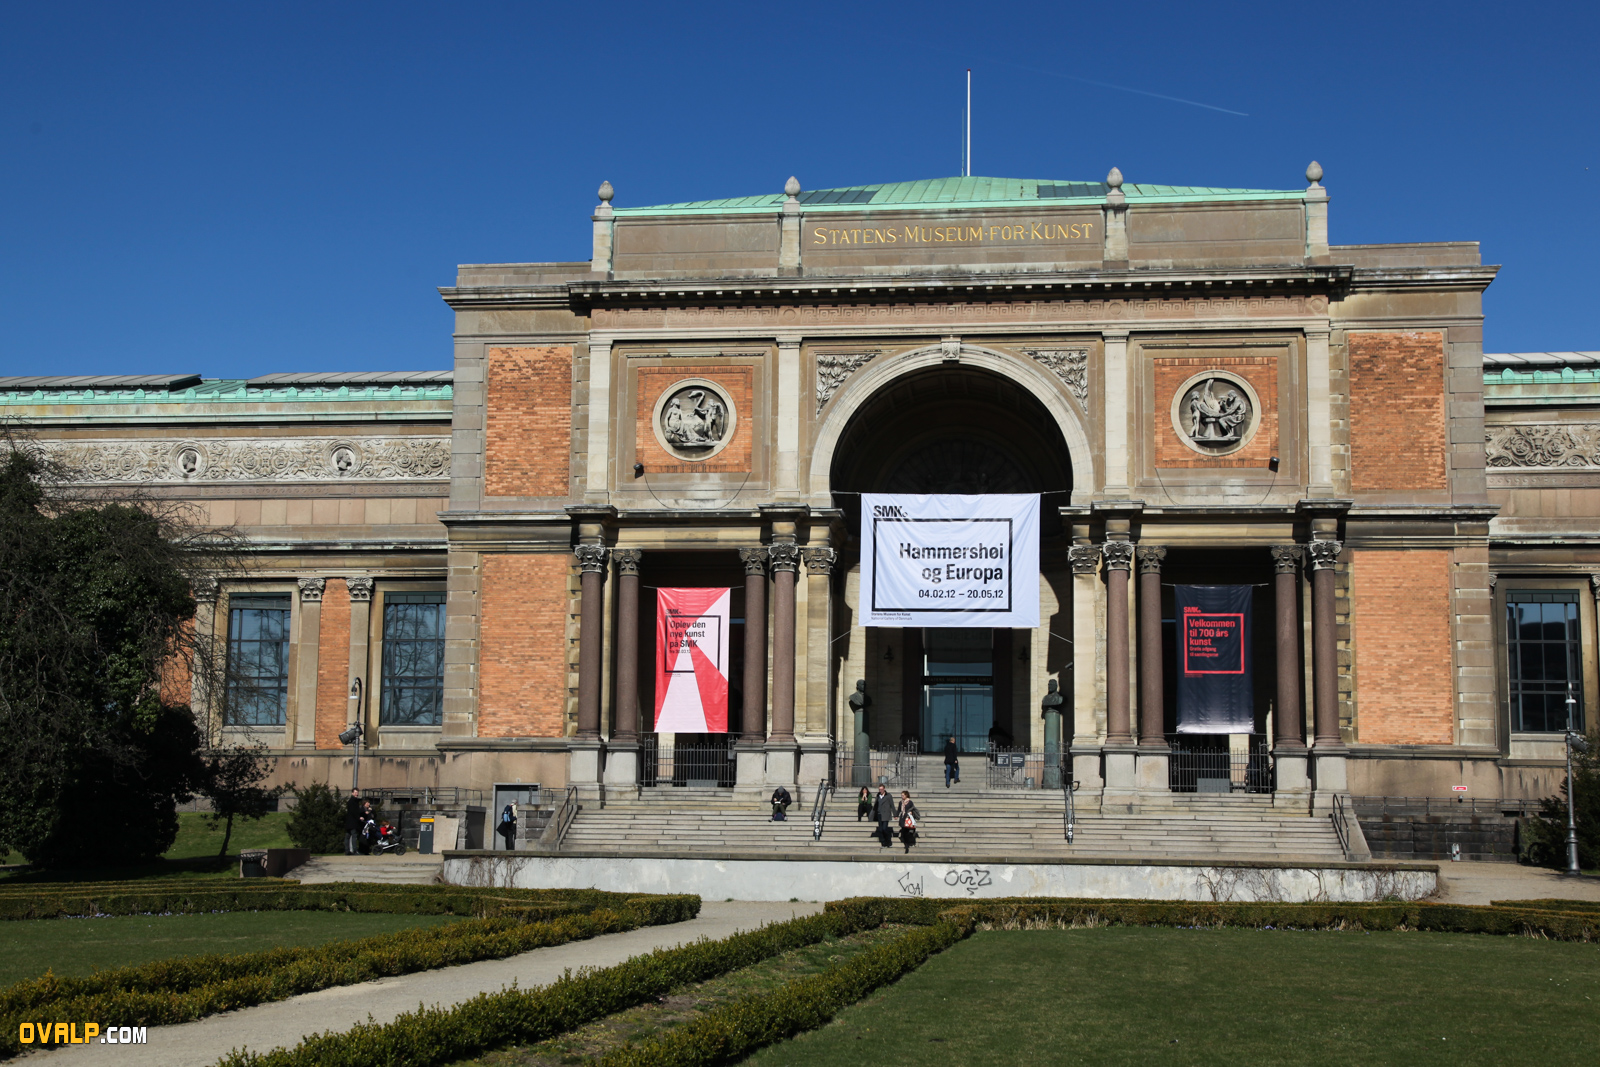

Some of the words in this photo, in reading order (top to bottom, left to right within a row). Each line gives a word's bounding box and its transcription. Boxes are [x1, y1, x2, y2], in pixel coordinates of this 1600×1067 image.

[900, 543, 1004, 560] Hammershøi
[921, 567, 942, 583] og
[946, 564, 1003, 584] Europa
[918, 590, 956, 599] 04.02.12
[967, 590, 1004, 599] 20.05.12
[670, 621, 691, 629] Oplev
[1189, 619, 1236, 628] Velkommen
[1189, 629, 1198, 637] til
[1199, 629, 1215, 637] 700
[1216, 628, 1229, 637] års
[670, 640, 680, 649] på
[680, 640, 698, 648] SMK
[1189, 638, 1212, 646] kunst
